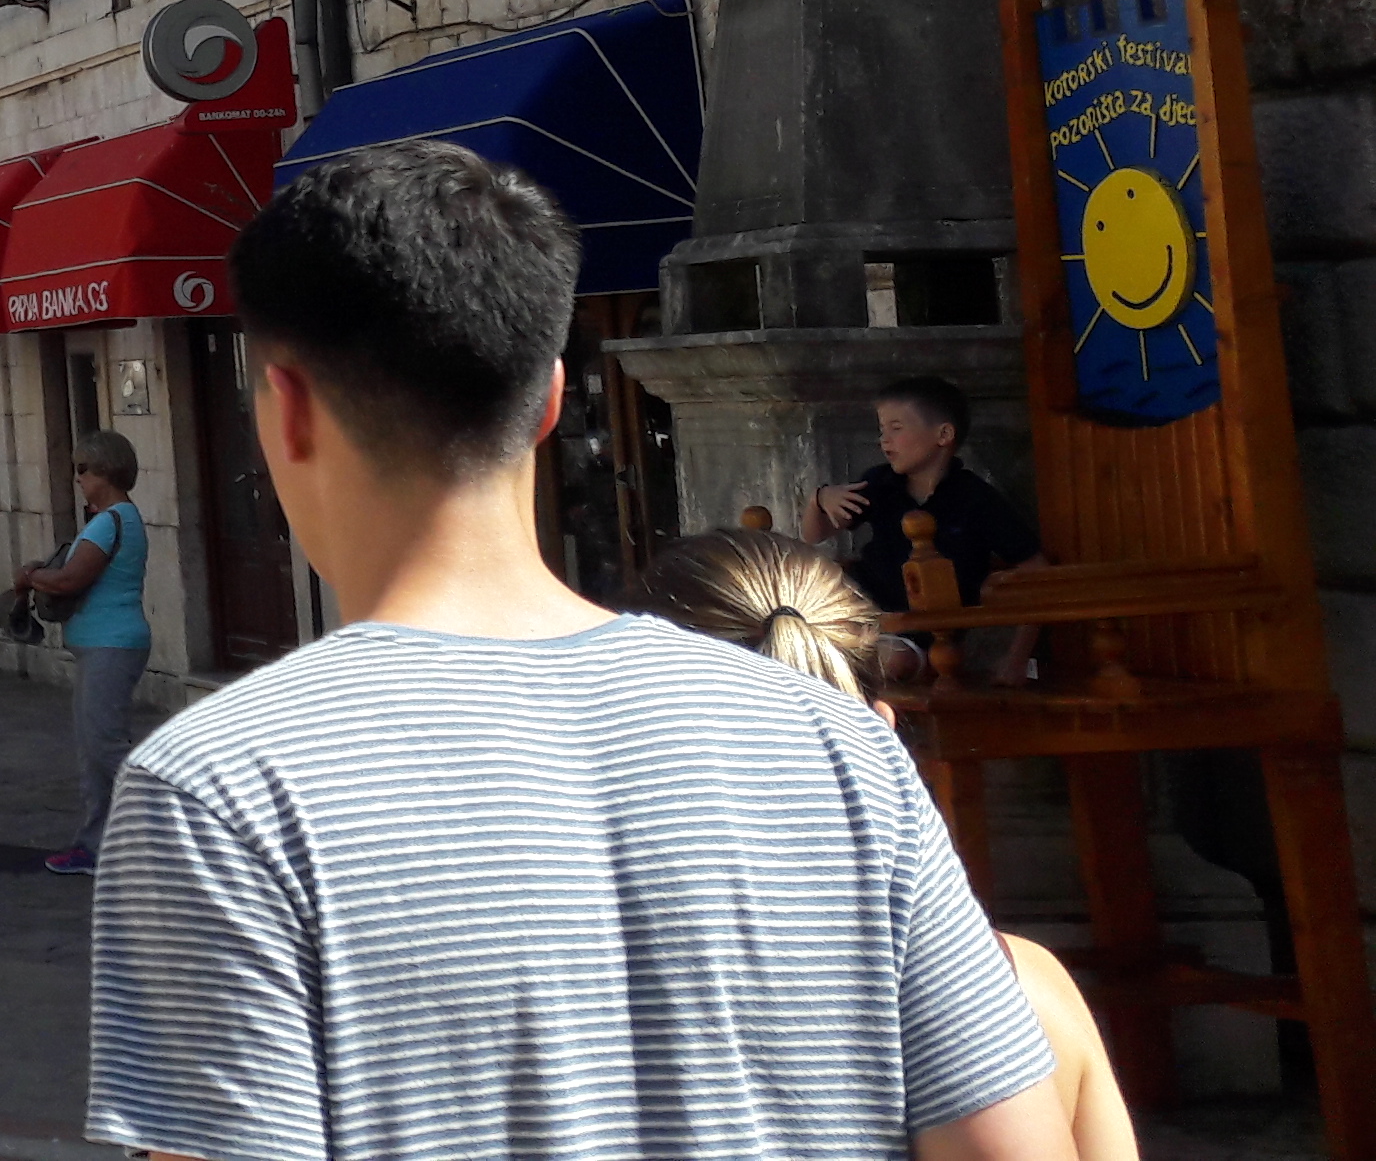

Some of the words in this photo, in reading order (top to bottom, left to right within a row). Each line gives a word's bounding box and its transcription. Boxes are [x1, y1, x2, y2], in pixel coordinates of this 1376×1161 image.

[1129, 89, 1154, 117] za
[1159, 93, 1197, 127] djec
[42, 284, 90, 321] BANKA
